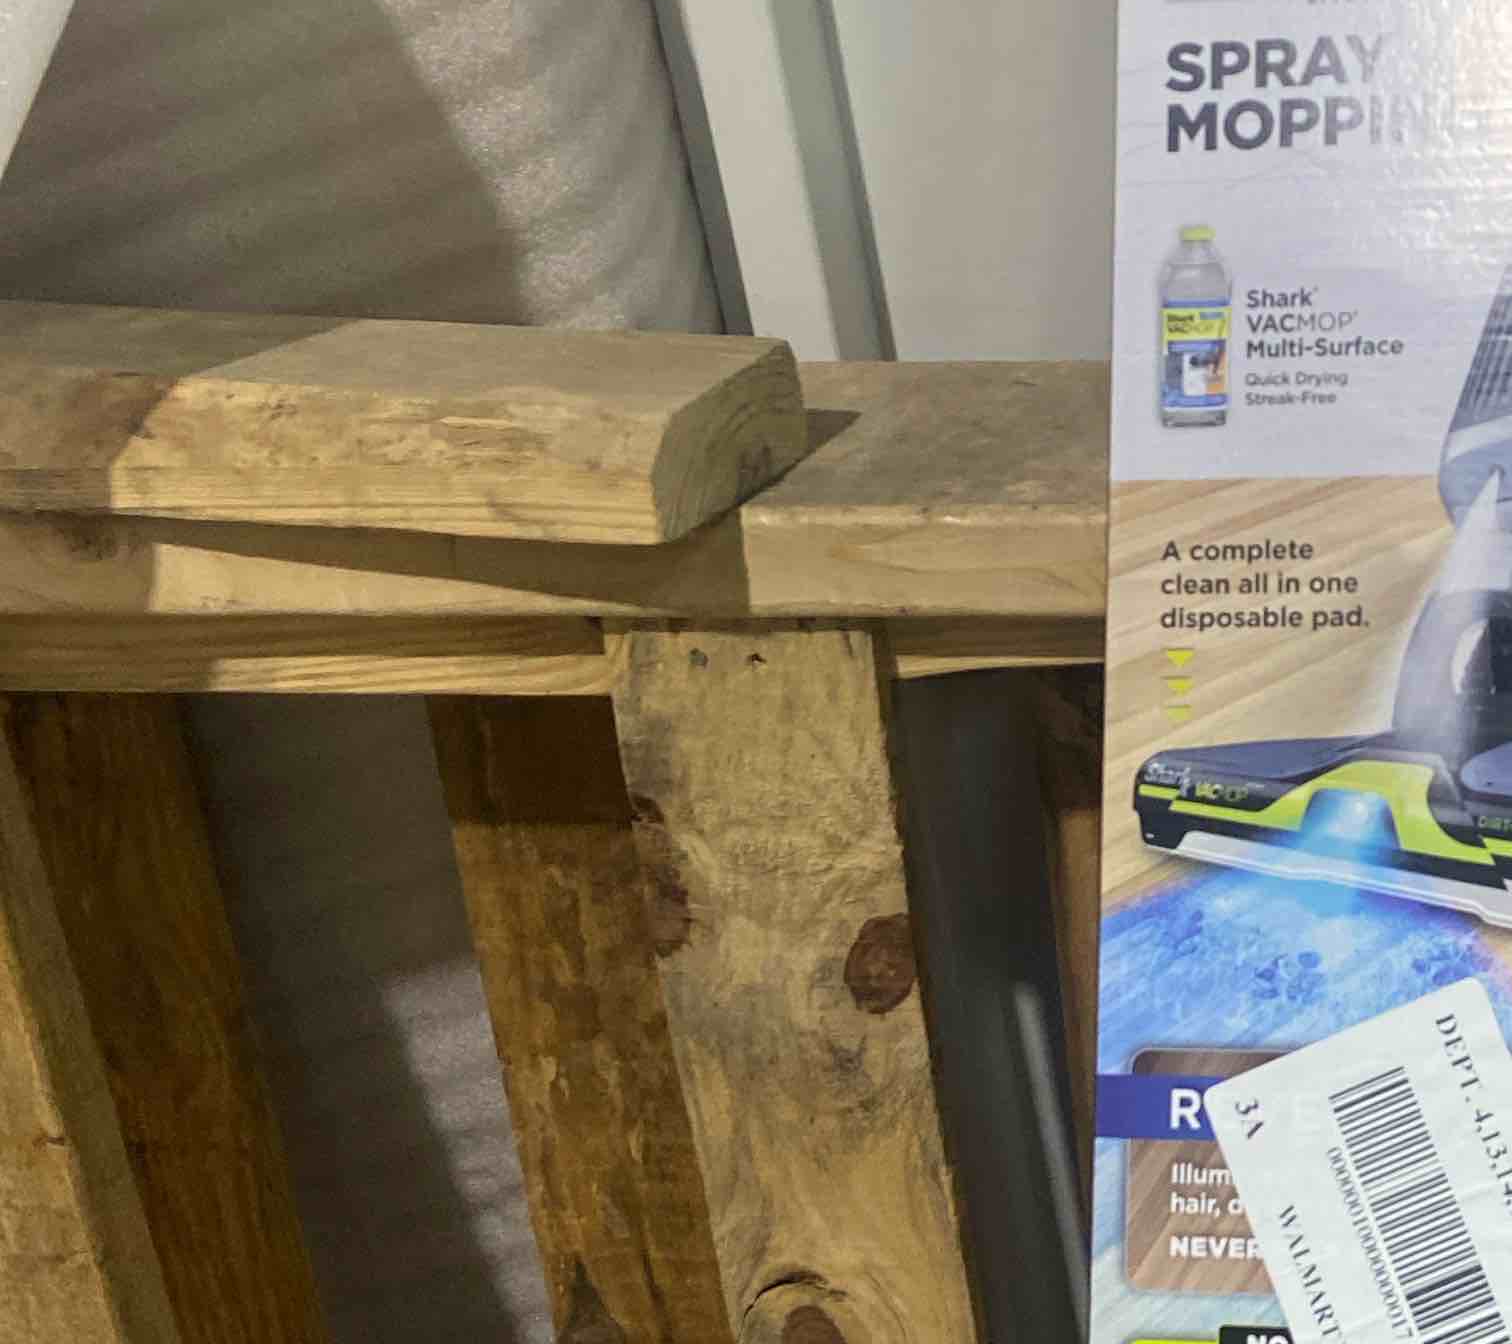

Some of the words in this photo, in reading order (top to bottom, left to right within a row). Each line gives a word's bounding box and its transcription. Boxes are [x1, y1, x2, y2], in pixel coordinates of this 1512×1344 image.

[1166, 34, 1384, 91] SPRAY
[1246, 286, 1312, 308] Shark
[1247, 311, 1353, 333] VACMOP
[1246, 335, 1404, 358] Multi-Surface
[1245, 371, 1289, 386] Quick
[1296, 369, 1348, 387] Drying
[1161, 540, 1181, 560] A
[1190, 539, 1313, 563] complete
[1161, 573, 1229, 594] clean
[1239, 573, 1268, 594] all
[1278, 572, 1300, 594] in
[1309, 575, 1358, 594] one
[1161, 606, 1303, 632] disposable
[1312, 606, 1370, 631] pad.
[1436, 1014, 1482, 1102] DEPT.
[1235, 1099, 1263, 1140] 3A
[1171, 1163, 1231, 1184] Illum
